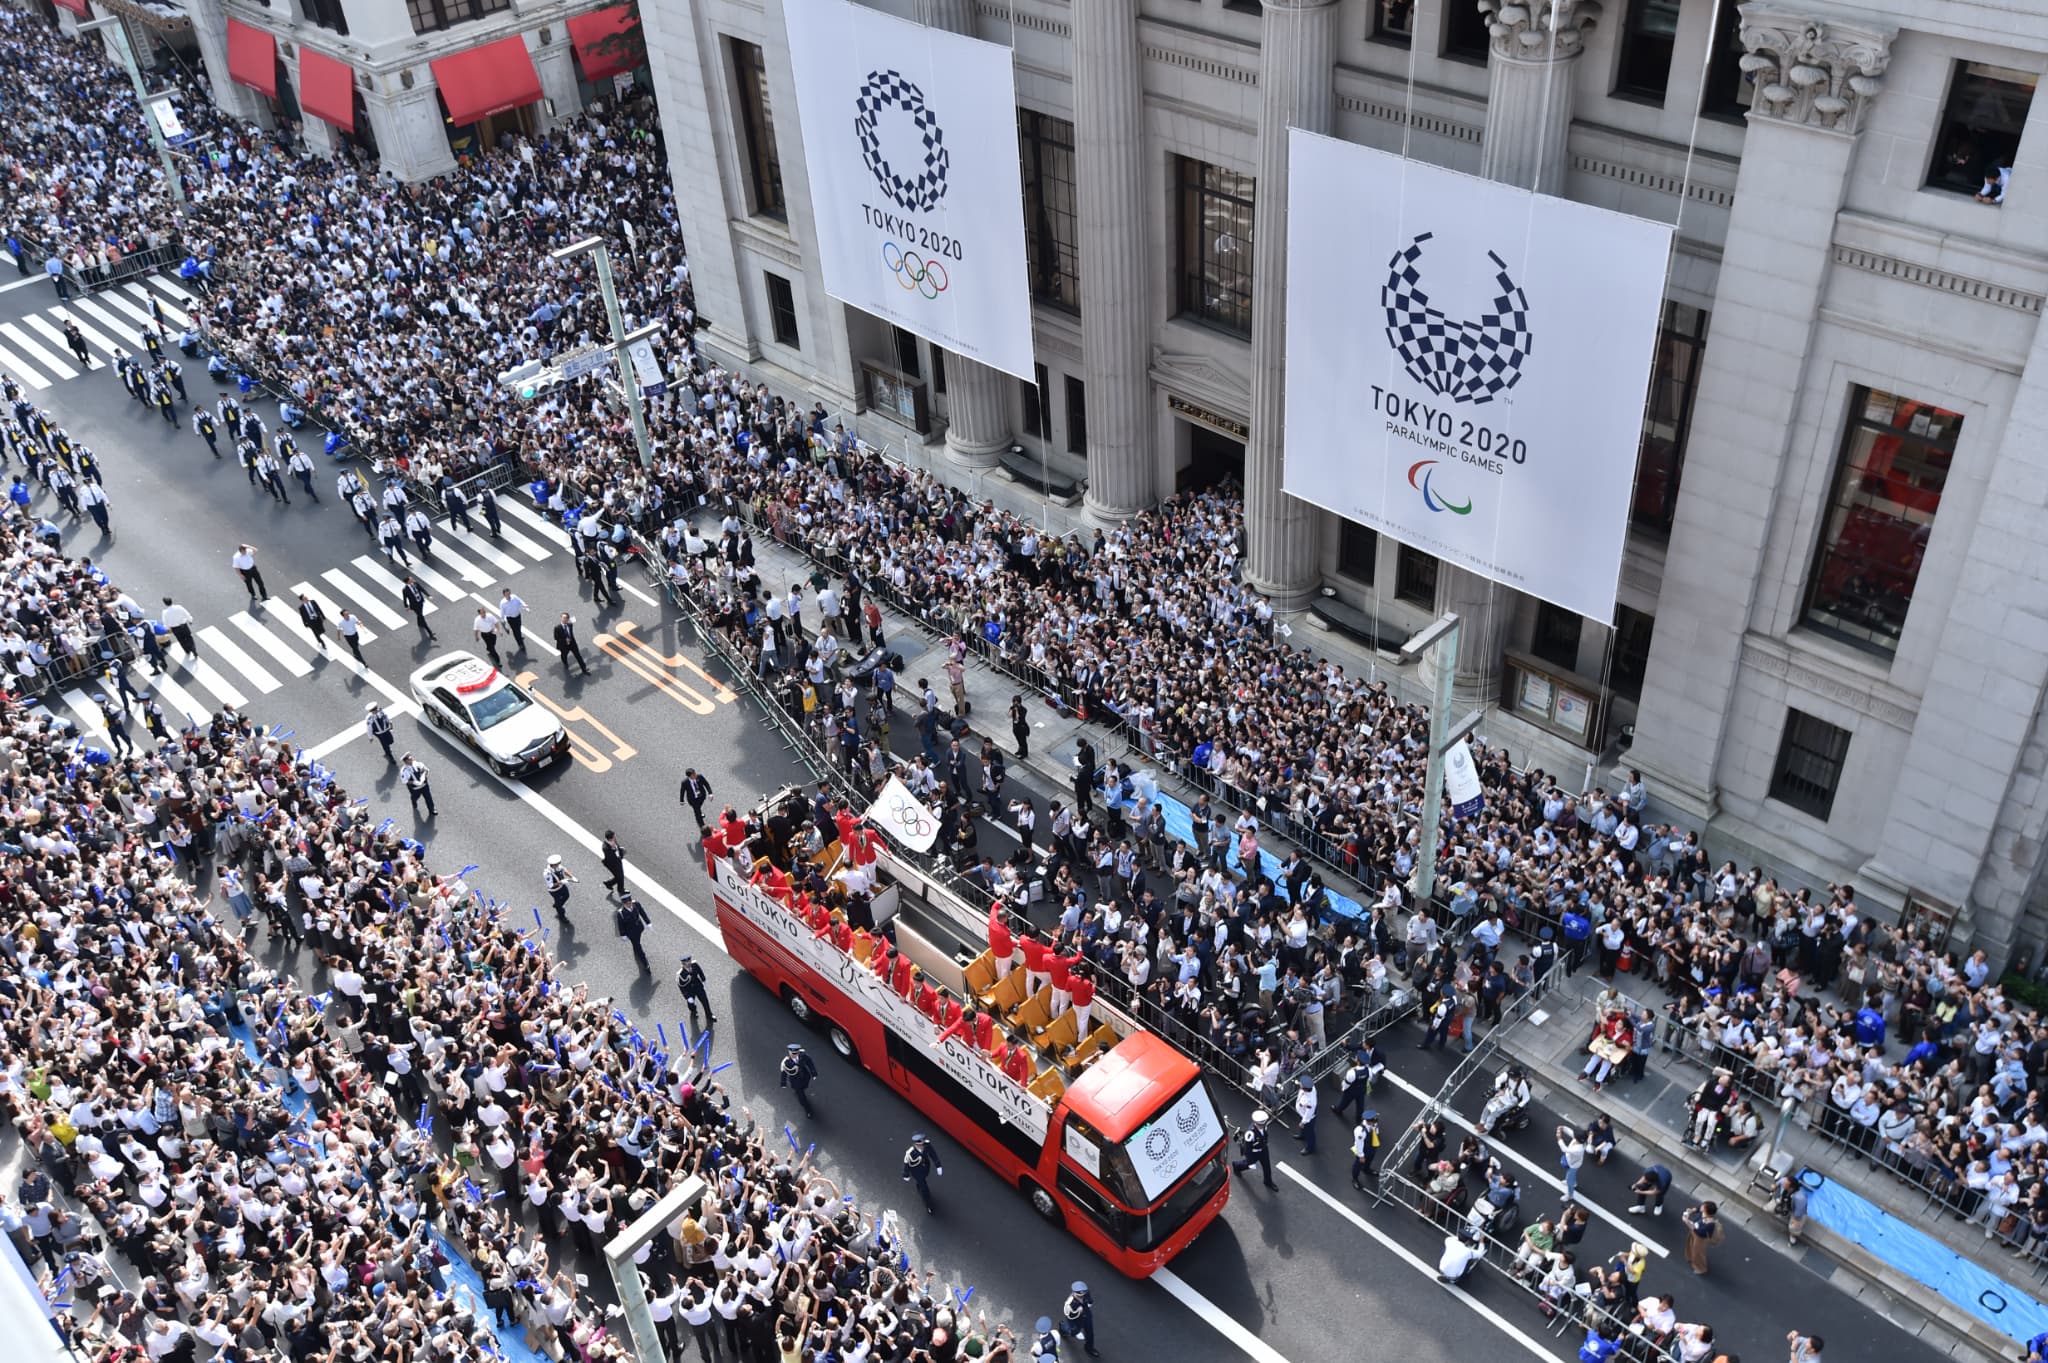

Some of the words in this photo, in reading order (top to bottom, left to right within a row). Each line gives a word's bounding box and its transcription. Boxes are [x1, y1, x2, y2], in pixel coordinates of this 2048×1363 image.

[862, 203, 916, 243] TOKYO
[920, 227, 963, 261] 2020
[1371, 384, 1453, 437] TOKYO
[1459, 420, 1527, 465] 2020
[1386, 421, 1458, 458] PARALYMPIC
[1461, 450, 1504, 475] GAMES
[727, 875, 749, 901] Go!
[752, 892, 798, 938] TOKYO
[945, 1041, 971, 1070] Go!
[976, 1063, 1032, 1116] TOKYO
